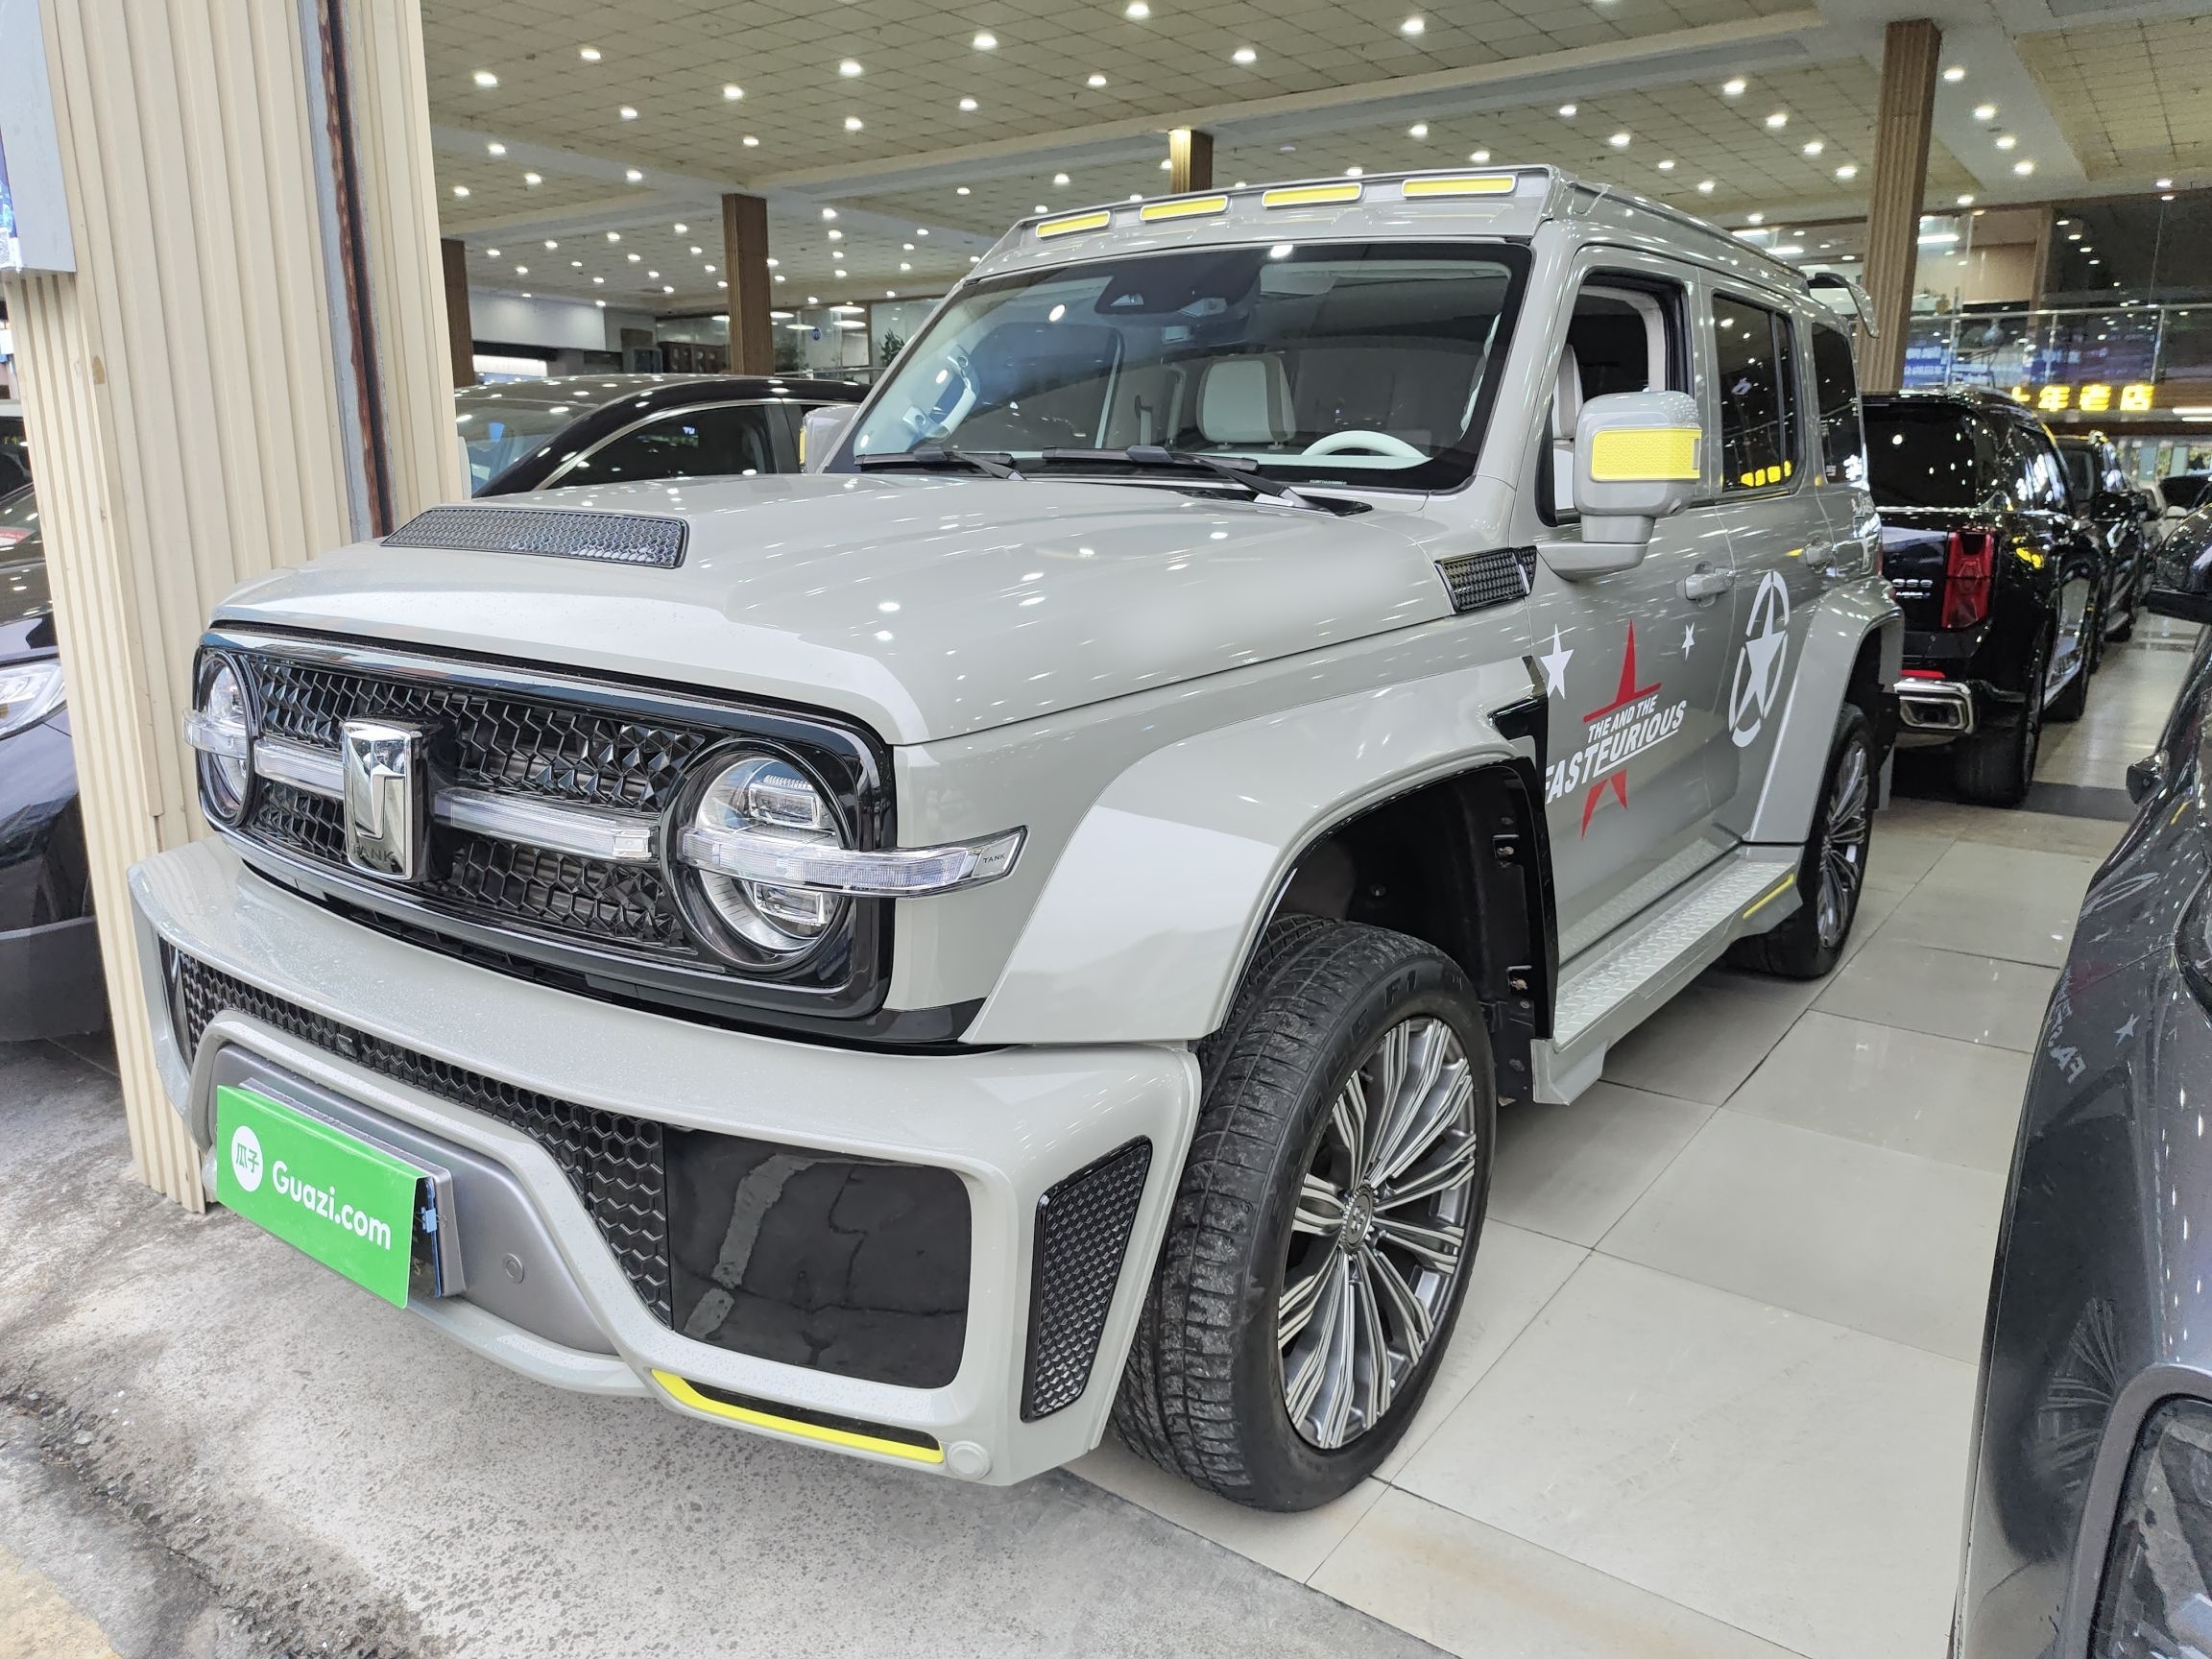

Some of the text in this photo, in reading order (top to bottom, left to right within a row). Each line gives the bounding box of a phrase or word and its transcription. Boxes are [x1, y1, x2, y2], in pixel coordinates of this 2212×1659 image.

[1588, 694, 1658, 742] THE AND THE
[353, 845, 395, 862] TANK
[983, 853, 1006, 863] TANK
[235, 1143, 259, 1172] 瓜子
[272, 1161, 391, 1250] Guazi.com
